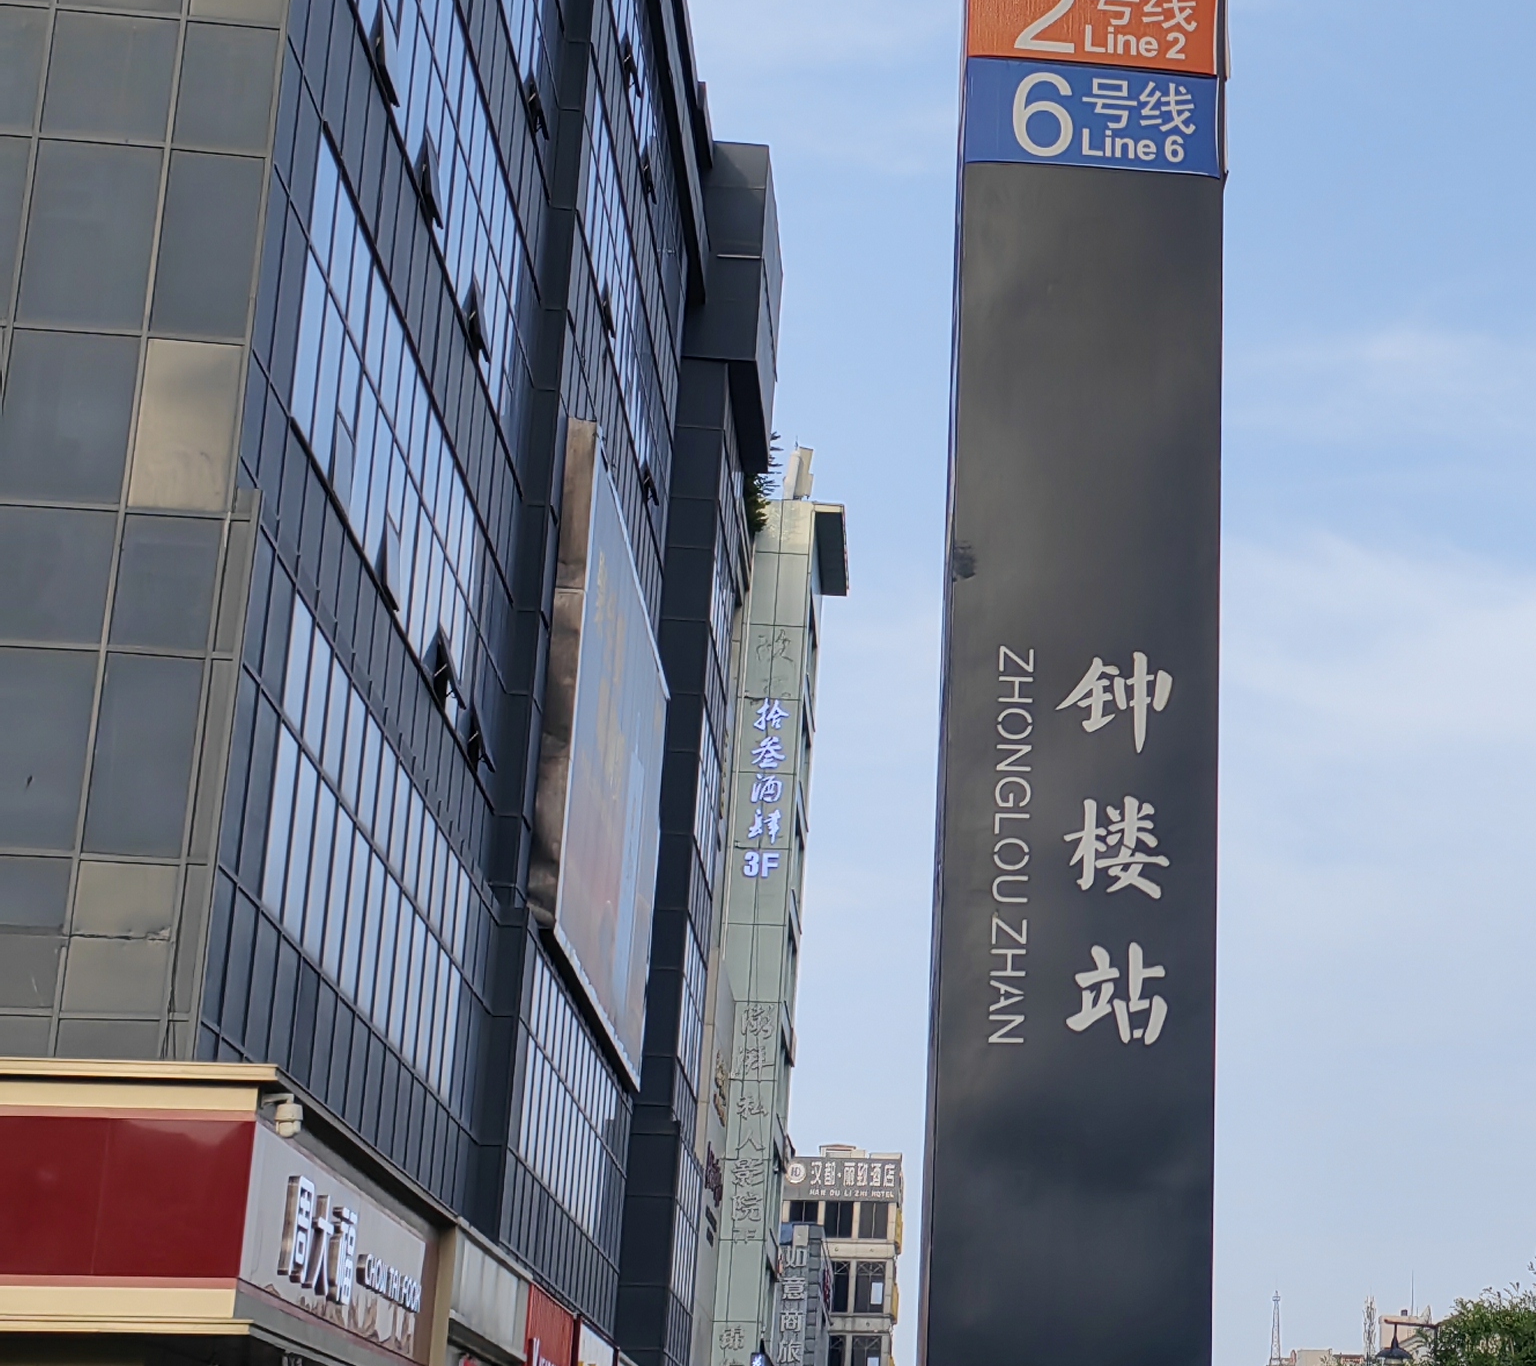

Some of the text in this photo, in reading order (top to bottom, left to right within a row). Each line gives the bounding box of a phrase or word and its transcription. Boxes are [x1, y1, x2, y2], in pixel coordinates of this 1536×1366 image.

[1083, 25, 1187, 60] Line 2
[1011, 70, 1196, 159] 6号线
[1081, 126, 1185, 161] Line 6
[743, 851, 780, 878] 3F
[987, 645, 1035, 1046] ZHONGLOU ZHAN
[1055, 650, 1173, 1046] 钟楼站
[287, 1174, 359, 1307] 周大福
[365, 1252, 422, 1314] CHOW TAI FOOK
